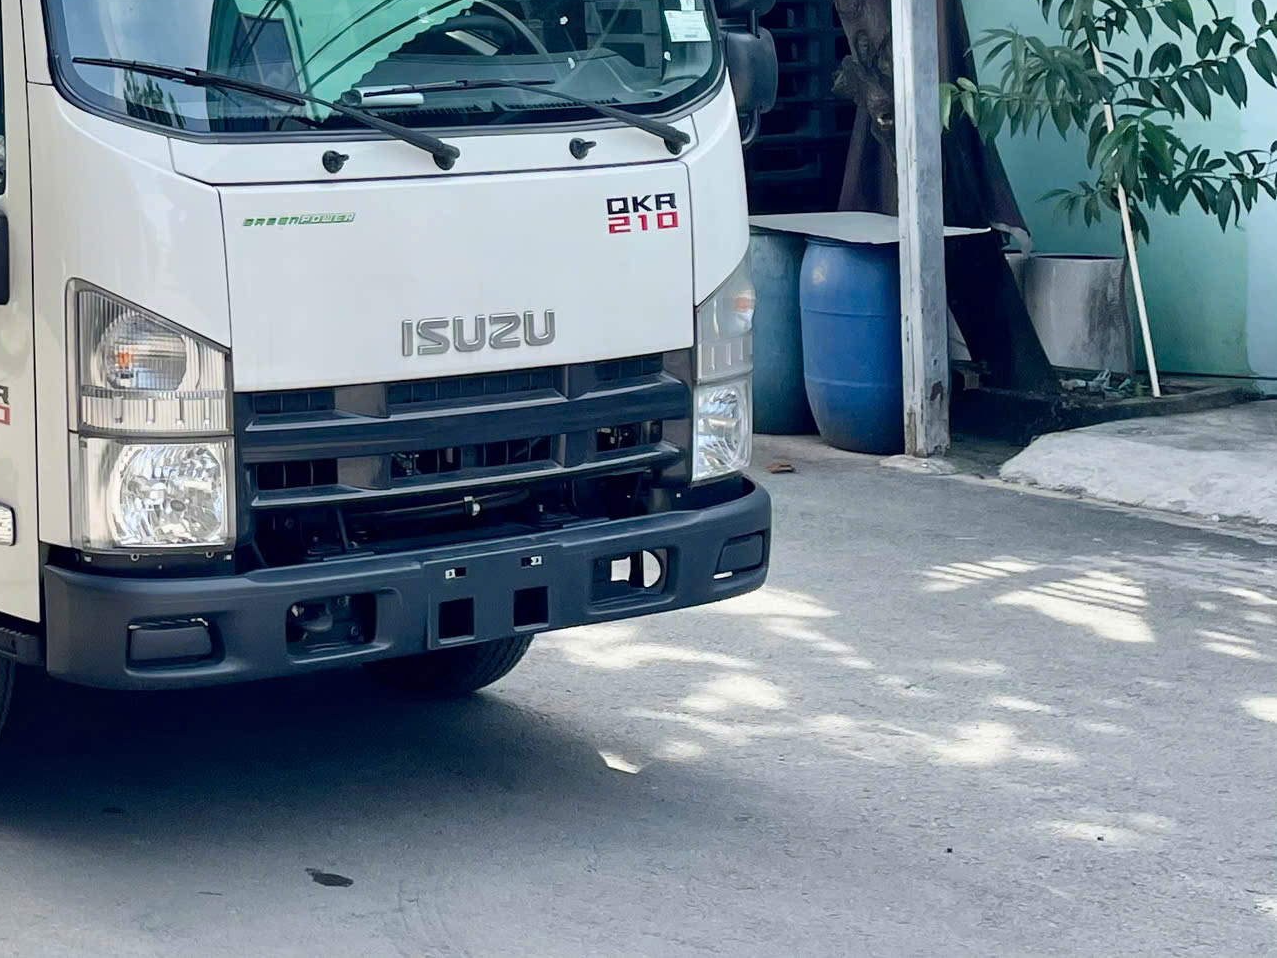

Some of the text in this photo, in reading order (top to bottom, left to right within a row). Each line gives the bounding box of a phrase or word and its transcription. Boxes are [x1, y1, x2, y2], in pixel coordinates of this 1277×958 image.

[606, 193, 677, 215] QKR
[608, 211, 679, 234] 210
[402, 309, 556, 357] ISUZU
